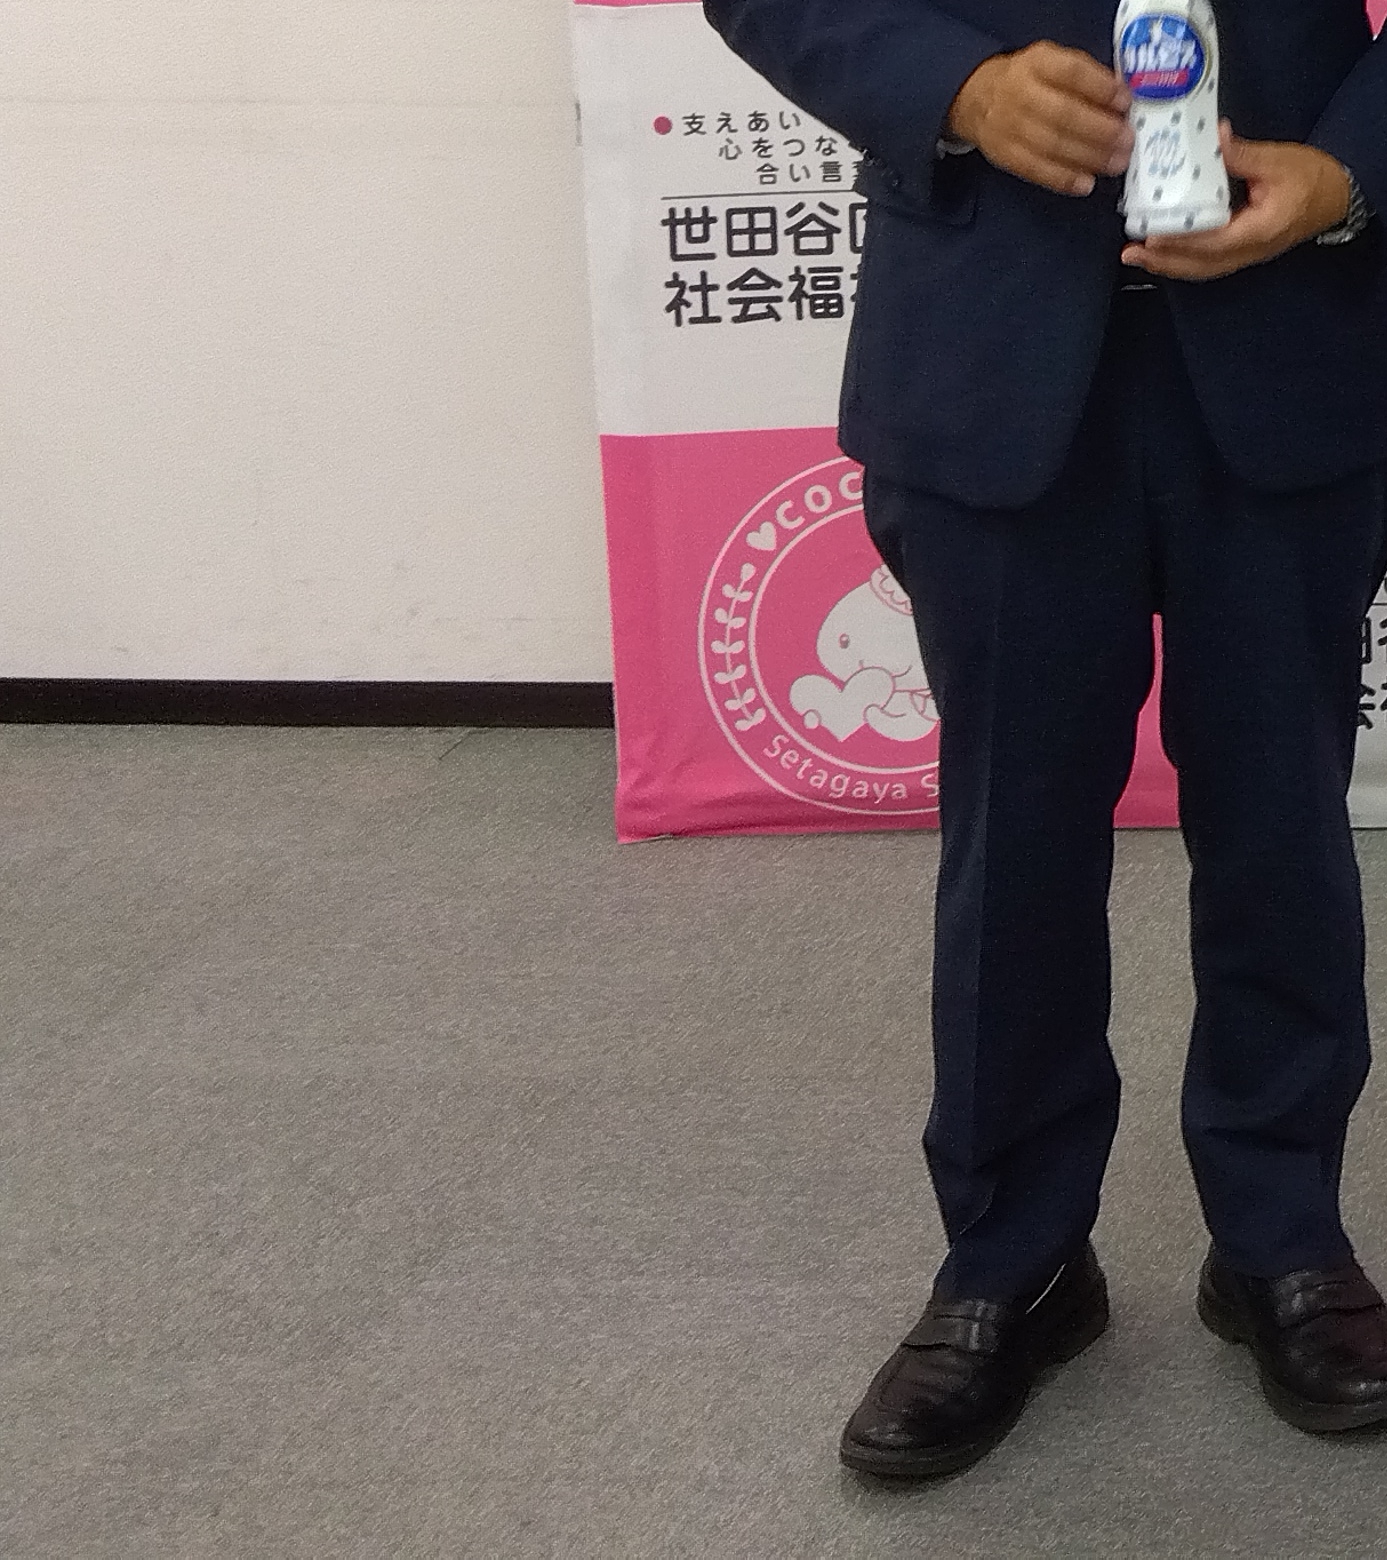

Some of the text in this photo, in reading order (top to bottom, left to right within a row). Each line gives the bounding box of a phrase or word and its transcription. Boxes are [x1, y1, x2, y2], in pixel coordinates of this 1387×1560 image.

[681, 110, 802, 137] 支えあい
[718, 134, 865, 161] 心をつな
[663, 265, 861, 328] 社会福
[762, 732, 908, 805] Setagaya
